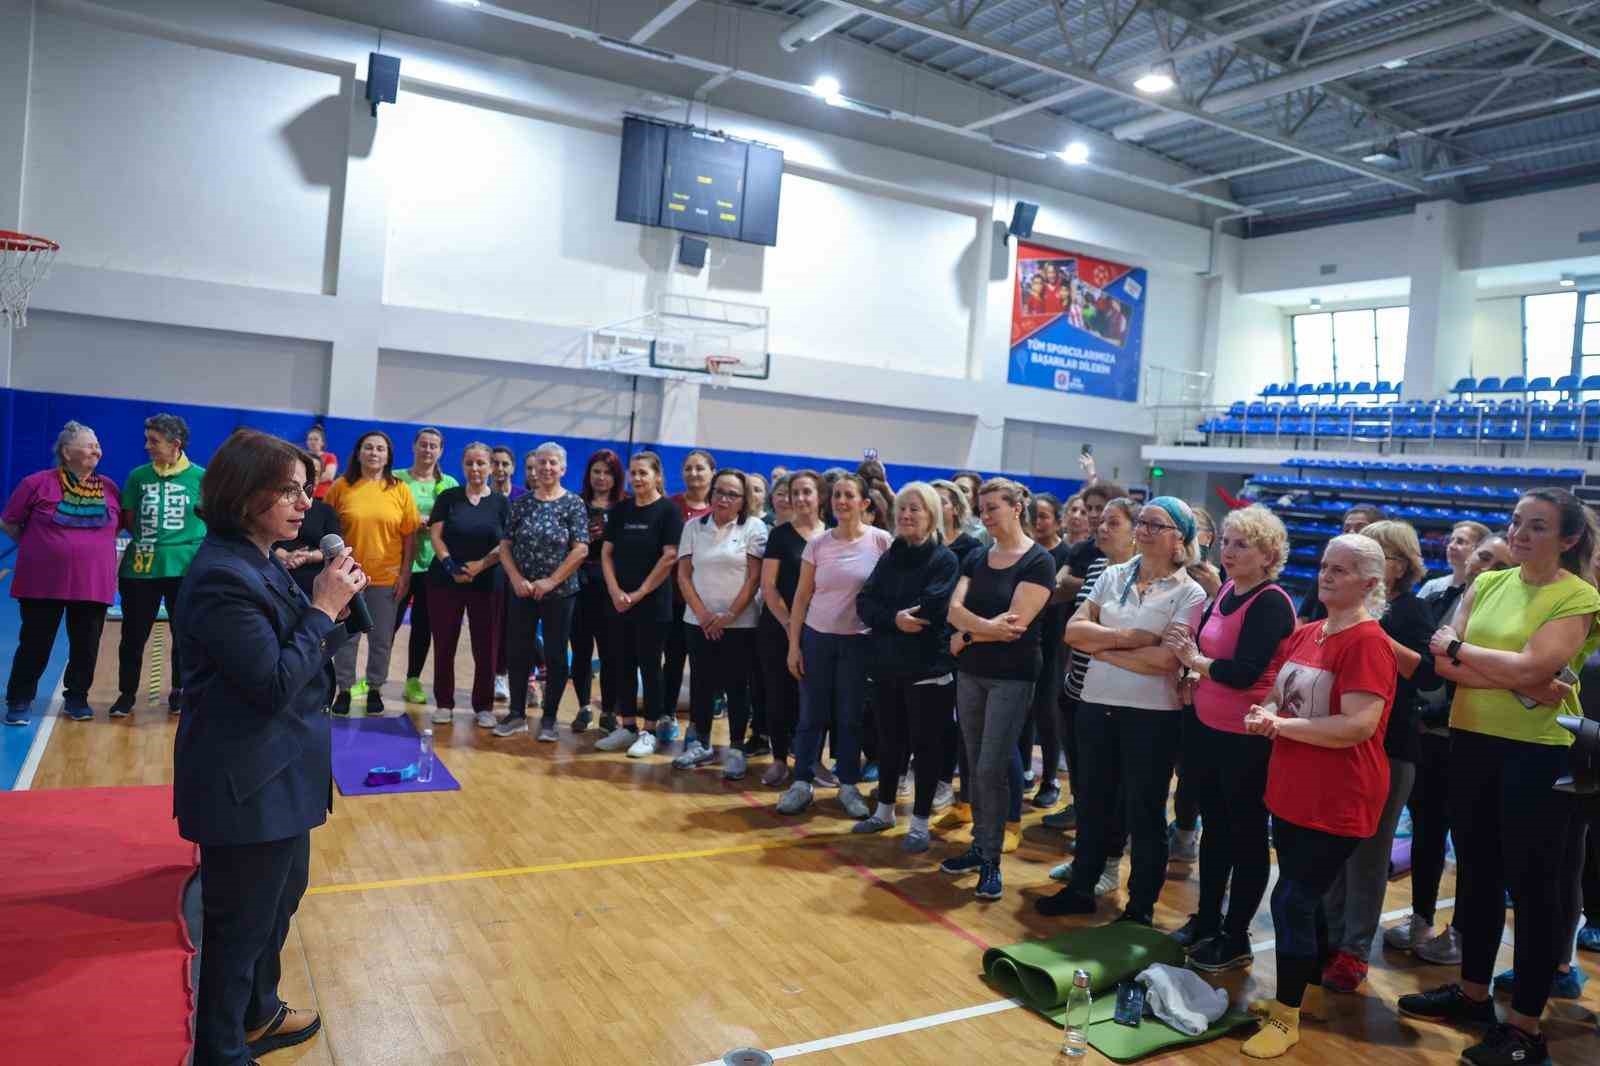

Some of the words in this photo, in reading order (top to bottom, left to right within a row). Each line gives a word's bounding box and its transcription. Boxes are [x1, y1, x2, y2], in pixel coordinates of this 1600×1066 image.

[1027, 338, 1045, 352] TÜM
[1031, 352, 1077, 369] BAŞARILAR
[134, 552, 154, 573] 87
